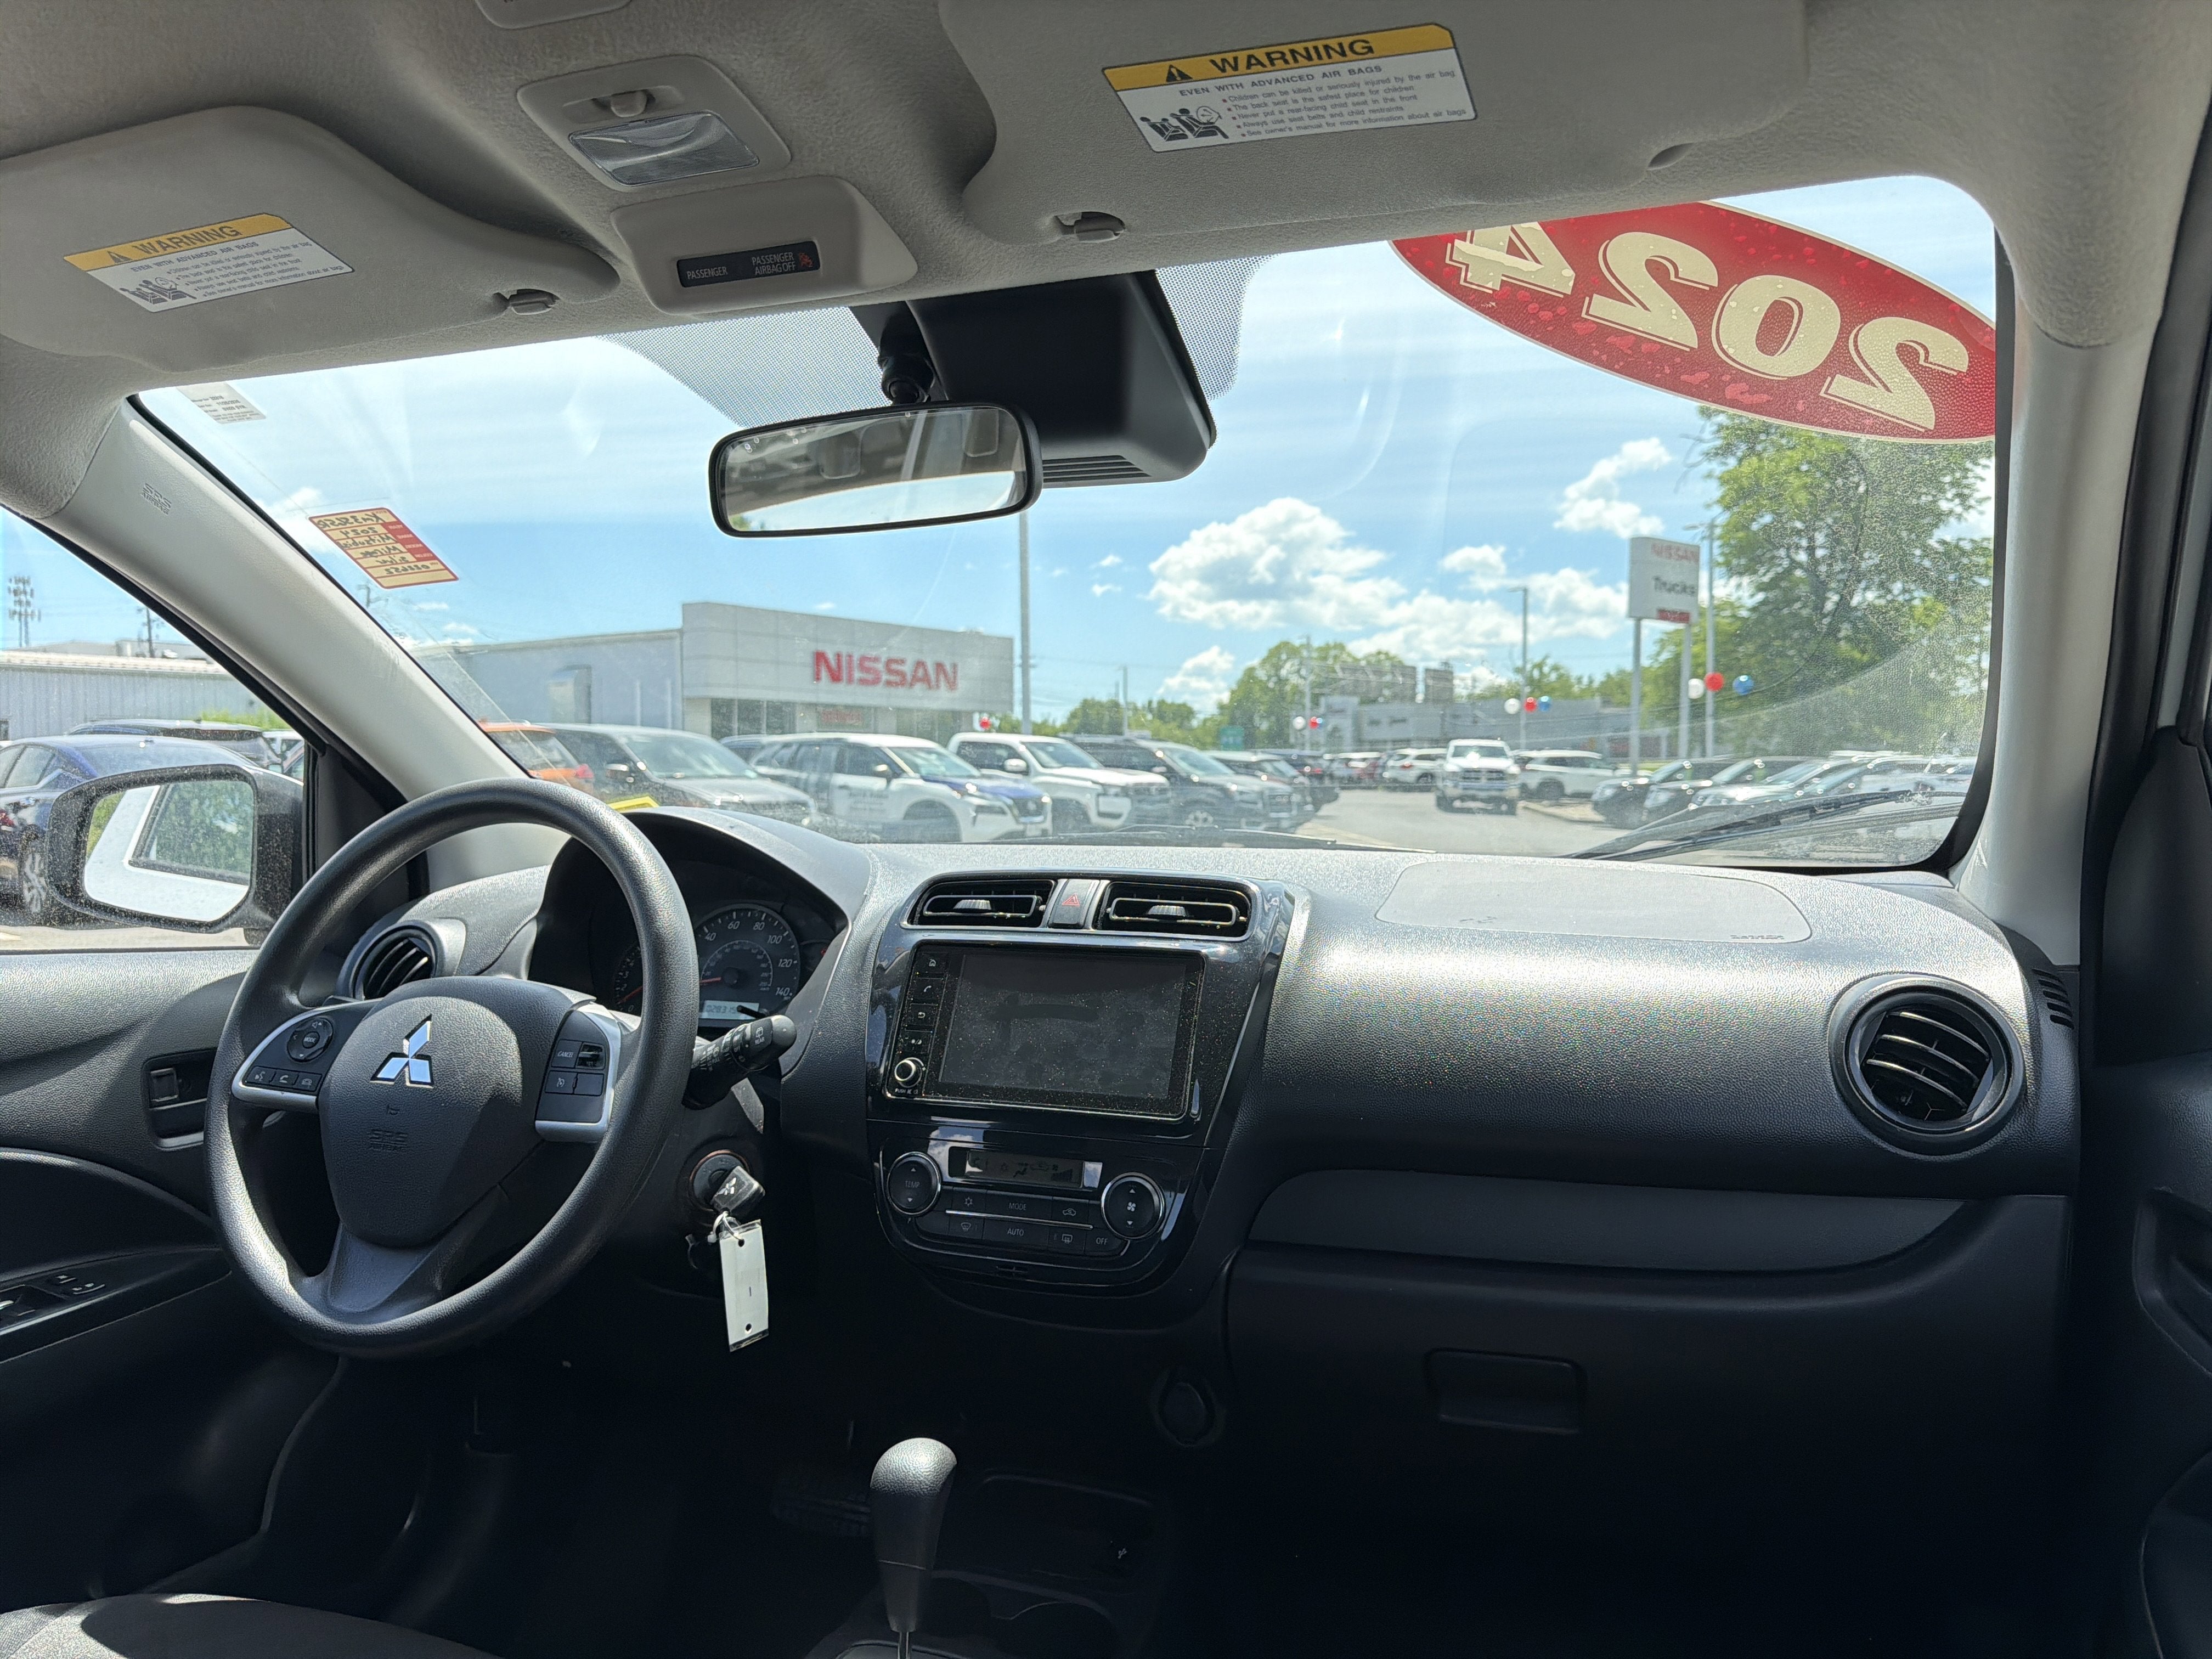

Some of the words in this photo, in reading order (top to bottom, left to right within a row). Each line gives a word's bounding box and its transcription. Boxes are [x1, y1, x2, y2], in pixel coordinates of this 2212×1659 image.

[1209, 39, 1375, 74] WARNING
[1180, 87, 1210, 97] EVEN
[1216, 83, 1244, 92] WITH
[1251, 74, 1315, 87] ADVANCED
[1322, 70, 1341, 79] AIR
[1348, 65, 1382, 76] BAGS
[1228, 93, 1259, 103] Children
[1328, 80, 1361, 92] seriously
[1365, 76, 1391, 87] injured
[1394, 75, 1404, 84] by
[1440, 69, 1455, 78] bag
[1251, 101, 1269, 109] back
[1318, 93, 1341, 101] safest
[1345, 90, 1365, 99] place
[1384, 85, 1414, 94] children
[1238, 111, 1260, 120] Never
[1263, 110, 1275, 118] put
[1243, 120, 1268, 129] Always
[1307, 112, 1325, 121] belts
[1368, 105, 1403, 114] restraints
[1265, 126, 1292, 134] owner's
[1296, 121, 1323, 131] manual
[1362, 115, 1404, 124] information
[1408, 112, 1430, 120] about
[1447, 108, 1466, 117] bags
[132, 225, 243, 255] WARNING
[131, 264, 153, 272] EVEN
[176, 250, 218, 263] ADVANCED
[235, 241, 259, 250] BAGS
[751, 252, 794, 266] PASSENGER
[686, 266, 729, 280] PASSENGER
[754, 263, 782, 275] AIRBAG
[782, 261, 797, 273] OFF
[143, 483, 172, 508] SRS
[140, 492, 169, 515] AIRBAG
[814, 650, 959, 691] NISSAN
[727, 921, 740, 929] 60
[753, 922, 765, 930] 80
[704, 933, 716, 941] 40
[767, 935, 783, 944] 100
[778, 960, 793, 968] 120
[775, 987, 791, 996] 140
[1008, 1202, 1027, 1211] MODE
[1007, 1227, 1025, 1237] AUTO
[1096, 1237, 1108, 1246] OFF
